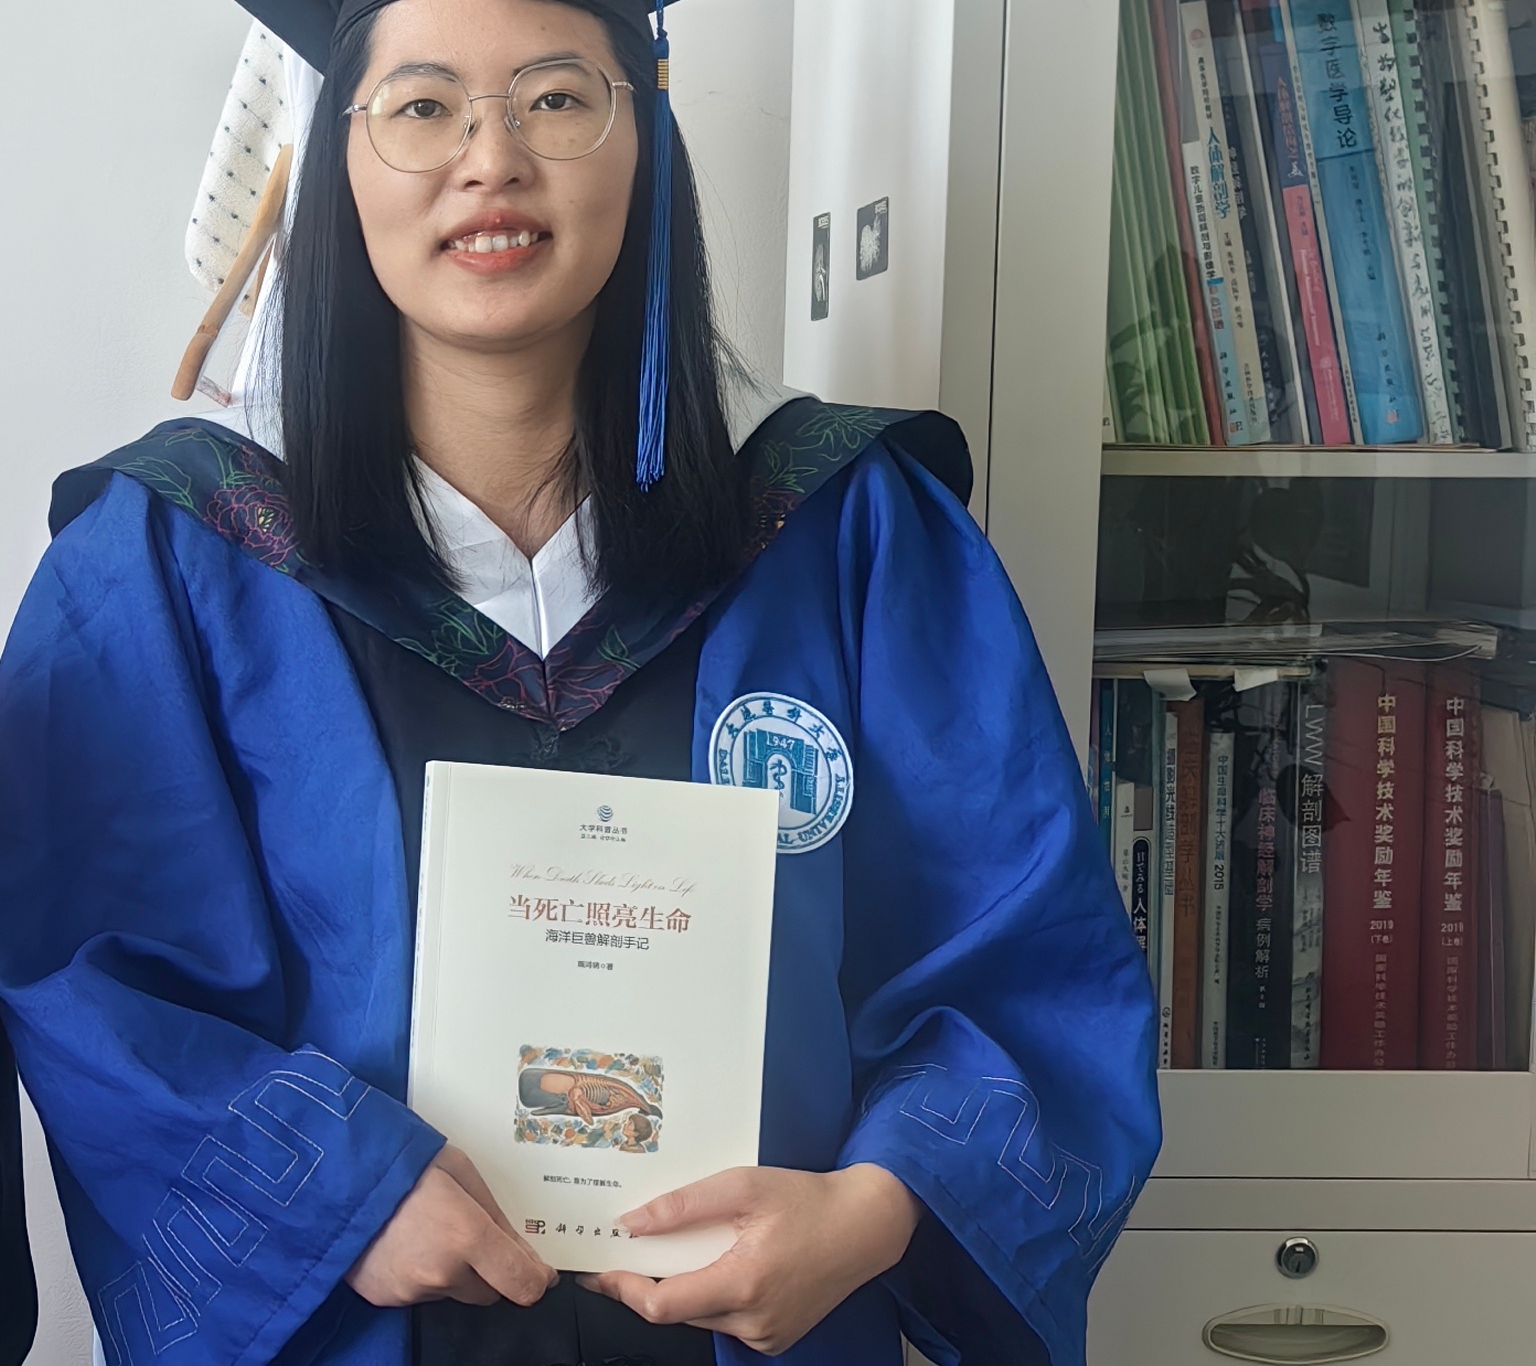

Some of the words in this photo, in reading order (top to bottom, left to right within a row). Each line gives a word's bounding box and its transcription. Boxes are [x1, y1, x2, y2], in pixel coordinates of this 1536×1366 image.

[1316, 12, 1358, 150] 数字医学导论
[765, 736, 796, 750] 1947
[1300, 772, 1325, 875] 解剖图谱
[1372, 693, 1397, 910] 中国科学技术奖励年鉴
[1442, 696, 1465, 912] 中国科学技术奖励年鉴
[508, 894, 693, 933] 当死亡照亮生命
[1214, 863, 1225, 891] 2015
